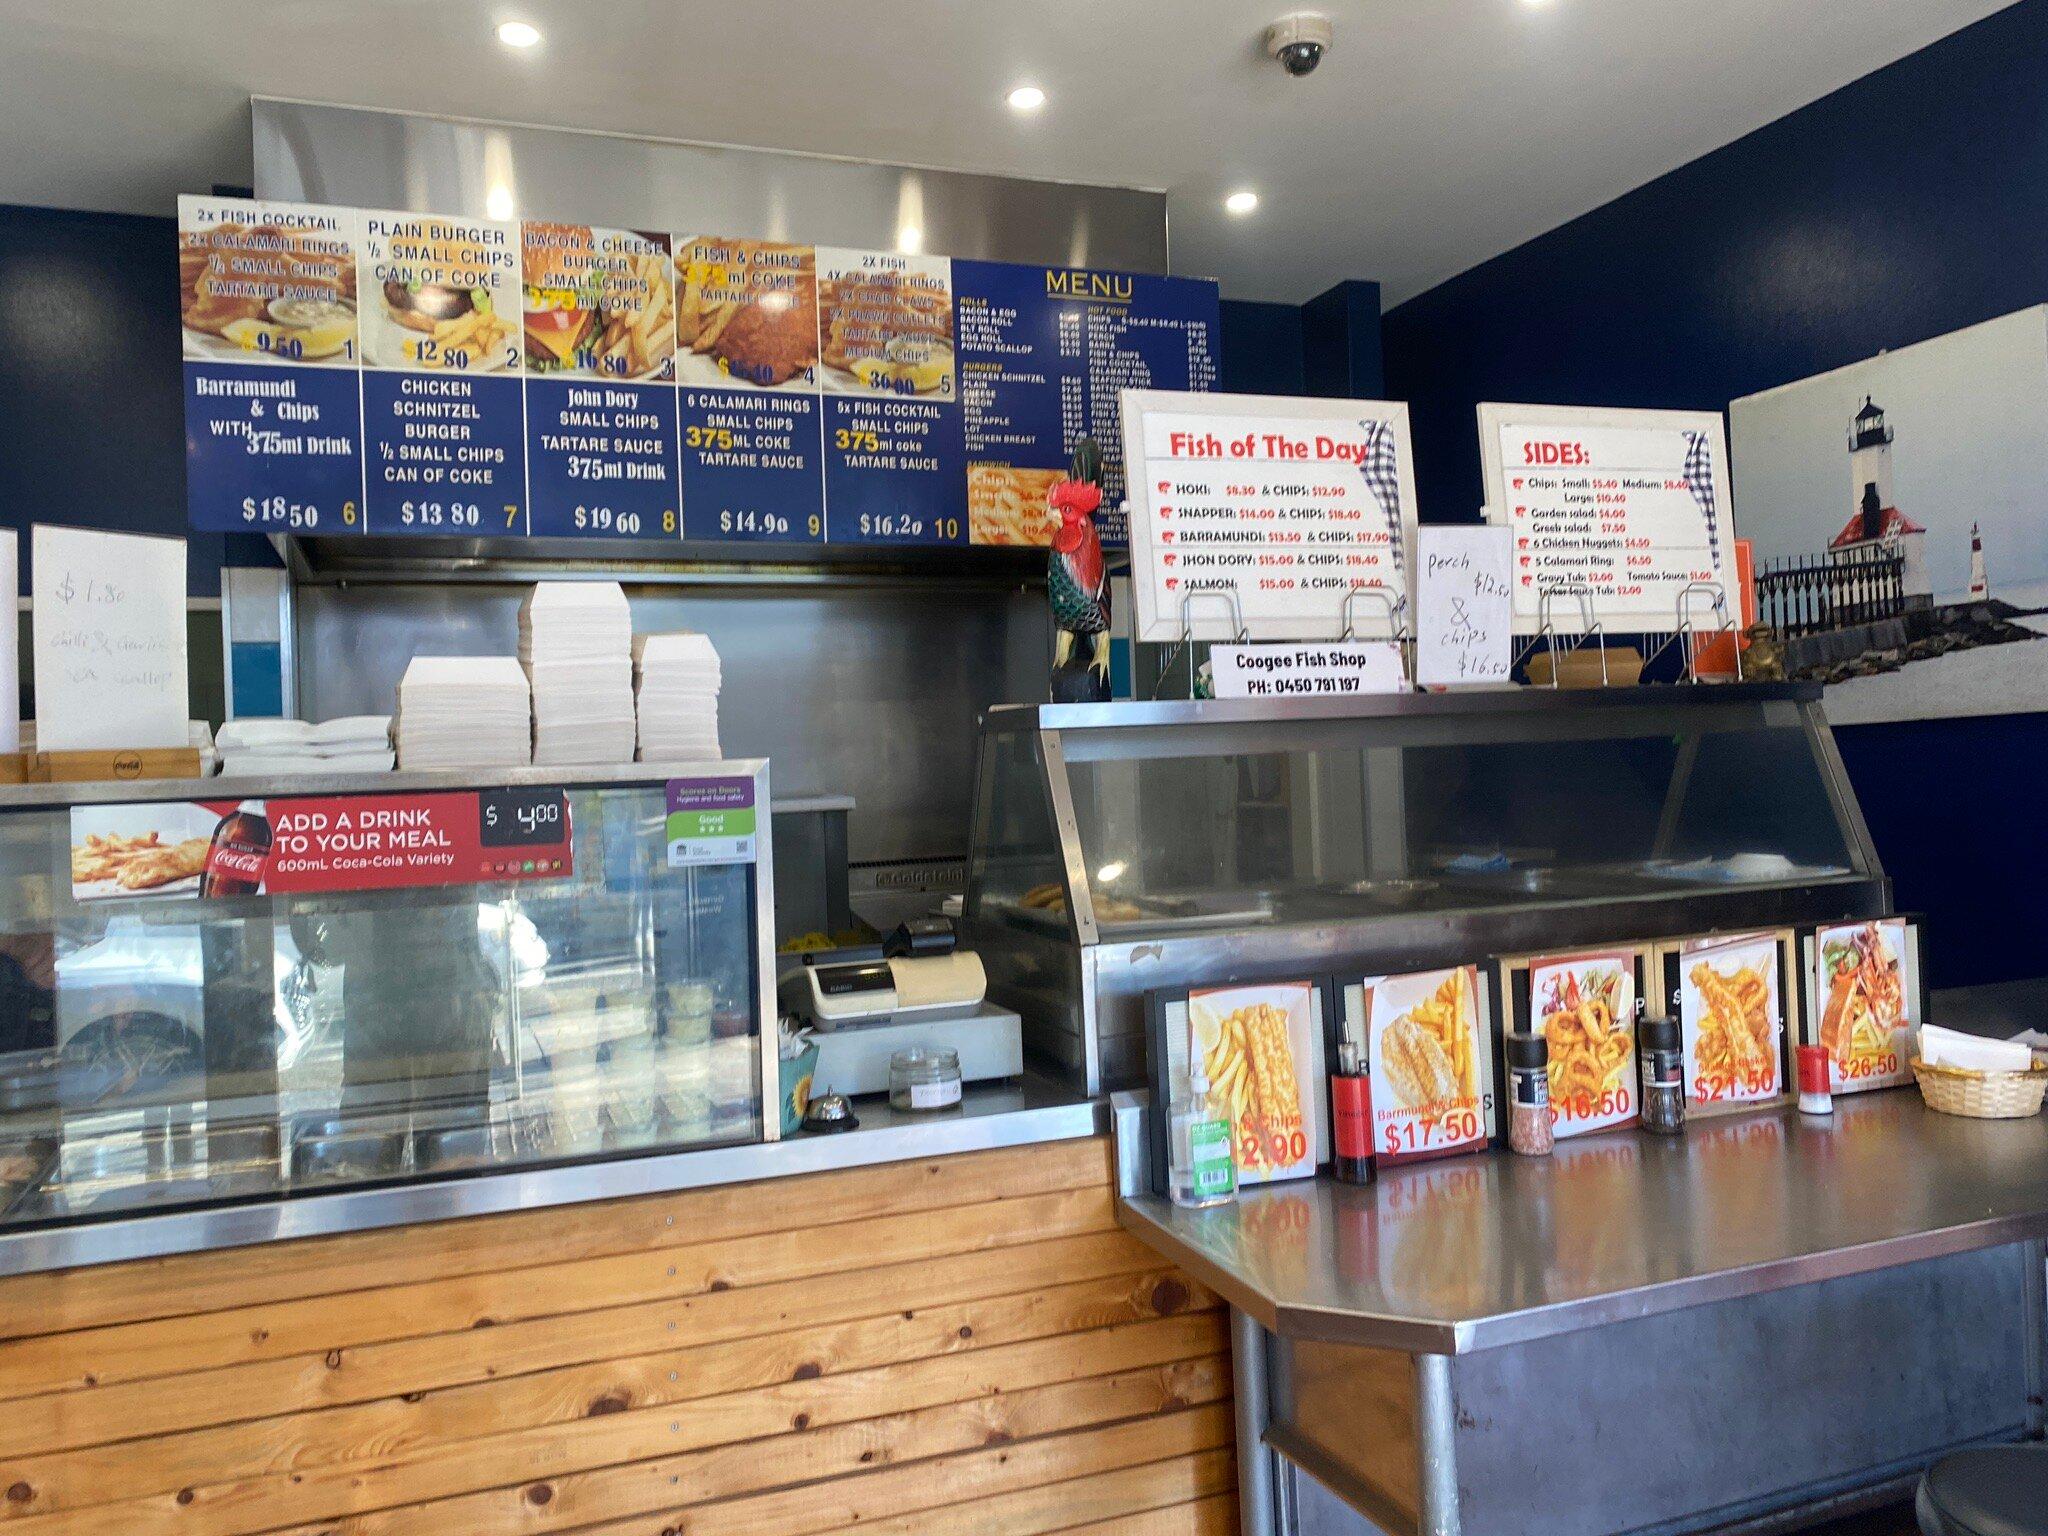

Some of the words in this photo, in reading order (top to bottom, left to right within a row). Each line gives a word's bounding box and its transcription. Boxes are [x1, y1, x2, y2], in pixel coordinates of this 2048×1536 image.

[221, 209, 256, 224] FISH
[262, 213, 340, 230] COCKTAIL
[368, 220, 422, 239] PLAIN
[430, 225, 505, 245] BURGER
[212, 233, 297, 252] CALAMARI
[301, 240, 350, 255] RINGS
[526, 231, 580, 250] BACON
[602, 238, 663, 256] CHEESE
[393, 244, 453, 263] SMALL
[461, 249, 514, 268] CHIPS
[563, 255, 628, 271] BURGER
[694, 246, 730, 263] FISH
[737, 250, 746, 265] &
[753, 251, 800, 269] CHIPS
[880, 256, 906, 270] FISH
[231, 257, 287, 276] SMALL
[291, 262, 339, 278] CHIPS
[375, 265, 413, 282] CAN
[421, 268, 444, 283] OF
[452, 271, 501, 288] COKE
[544, 272, 597, 289] SMALL
[602, 277, 648, 294] CHIPS
[752, 272, 796, 290] COKE
[909, 277, 945, 290] RINGS
[1046, 269, 1133, 299] MENU
[208, 280, 279, 299] TARTARE
[283, 286, 337, 303] SAUCE
[600, 296, 643, 312] COKE
[343, 339, 353, 360] 1
[506, 348, 519, 367] 2
[895, 348, 930, 363] CHIPS
[660, 356, 672, 378] 3
[804, 365, 815, 386] 4
[195, 376, 296, 398] Barramundi
[401, 379, 471, 397] CHICKEN
[941, 374, 951, 395] 5
[568, 388, 601, 408] John
[605, 389, 639, 410] Dory
[699, 394, 767, 411] CALAMARI
[771, 398, 811, 414] RINGS
[250, 398, 264, 417] &
[277, 401, 320, 423] Chips
[393, 400, 481, 419] SCHNITZEL
[854, 401, 881, 416] FISH
[884, 402, 941, 419] COCKTAIL
[559, 411, 610, 428] SMALL
[615, 413, 659, 430] CHIPS
[707, 413, 751, 429] SMALL
[755, 416, 794, 432] CHIPS
[851, 418, 891, 434] SMALL
[894, 420, 930, 436] CHIPS
[209, 419, 252, 439] WITH
[246, 430, 302, 455] 375ml
[307, 436, 352, 455] Drink
[405, 423, 471, 440] BURGER
[541, 434, 609, 453] TARTARE
[614, 438, 664, 455] SAUCE
[755, 435, 791, 450] COKE
[896, 439, 923, 453] coke
[1170, 432, 1223, 457] Fish
[1230, 433, 1256, 458] of
[1262, 434, 1308, 459] The
[1315, 436, 1369, 464] Day
[400, 444, 452, 462] SMALL
[457, 446, 505, 464] CHIPS
[698, 451, 757, 468] TARTARE
[761, 454, 804, 470] SAUCE
[844, 454, 897, 470] TARTARE
[900, 456, 939, 471] SAUCE
[1523, 440, 1590, 466] SIDES:
[384, 466, 418, 482] CAN
[423, 467, 444, 484] OF
[450, 468, 494, 485] COKE
[567, 455, 622, 481] 375ml
[627, 462, 666, 481] Drink
[1176, 484, 1211, 495] HOKI:
[1261, 484, 1271, 496] &
[1273, 484, 1310, 496] CHIPS:
[1528, 477, 1558, 490] Chips:
[1562, 478, 1591, 489] Small:
[1622, 478, 1662, 490] Medium:
[1564, 492, 1595, 504] Large:
[342, 500, 356, 526] 6
[503, 504, 518, 529] 7
[662, 509, 676, 533] 8
[1178, 507, 1237, 519] SNAPPER:
[1239, 508, 1275, 520] $14.00
[1278, 508, 1287, 520] &
[1289, 507, 1326, 519] CHIPS:
[1531, 507, 1567, 519] Garden
[1569, 507, 1598, 518] salad:
[808, 514, 820, 537] 9
[934, 517, 958, 540] 10
[1532, 522, 1561, 533] Greek
[1564, 522, 1593, 533] salad:
[1180, 530, 1266, 543] BARRAMUNDI:
[1307, 531, 1316, 543] &
[1318, 530, 1355, 543] CHIPS:
[1542, 538, 1580, 549] Chicken
[1582, 538, 1623, 550] Nuggets:
[1182, 555, 1215, 567] JHON
[1218, 554, 1257, 567] DORY:
[1259, 554, 1294, 567] $15.00
[1296, 554, 1306, 566] &
[1307, 553, 1344, 566] CHIPS:
[1543, 556, 1588, 567] Calamari
[1184, 578, 1238, 590] SALMON:
[1259, 577, 1295, 590] $15.00
[1311, 577, 1348, 589] CHIPS:
[1536, 572, 1565, 585] Gravy
[1627, 571, 1660, 581] Tomato
[1450, 596, 1471, 631] &
[1440, 628, 1488, 648] chips
[1236, 654, 1293, 672] Coogee
[1295, 652, 1327, 668] Fish
[1330, 651, 1367, 669] Shop
[1247, 680, 1272, 695] PH:
[1275, 677, 1313, 693] 0450
[276, 813, 328, 833] ADD
[335, 811, 352, 830] A
[360, 808, 432, 829] DRINK
[699, 814, 724, 826] Good
[276, 834, 309, 854] TO
[315, 832, 381, 853] YOUR
[388, 829, 452, 849] MEAL
[277, 857, 329, 873] 600mL
[332, 853, 403, 870] Coca-Cola
[407, 851, 455, 868] Variety
[1838, 1053, 1898, 1082] $26.50
[1694, 1068, 1774, 1105] $21.50
[1384, 1110, 1478, 1157] $17.50
